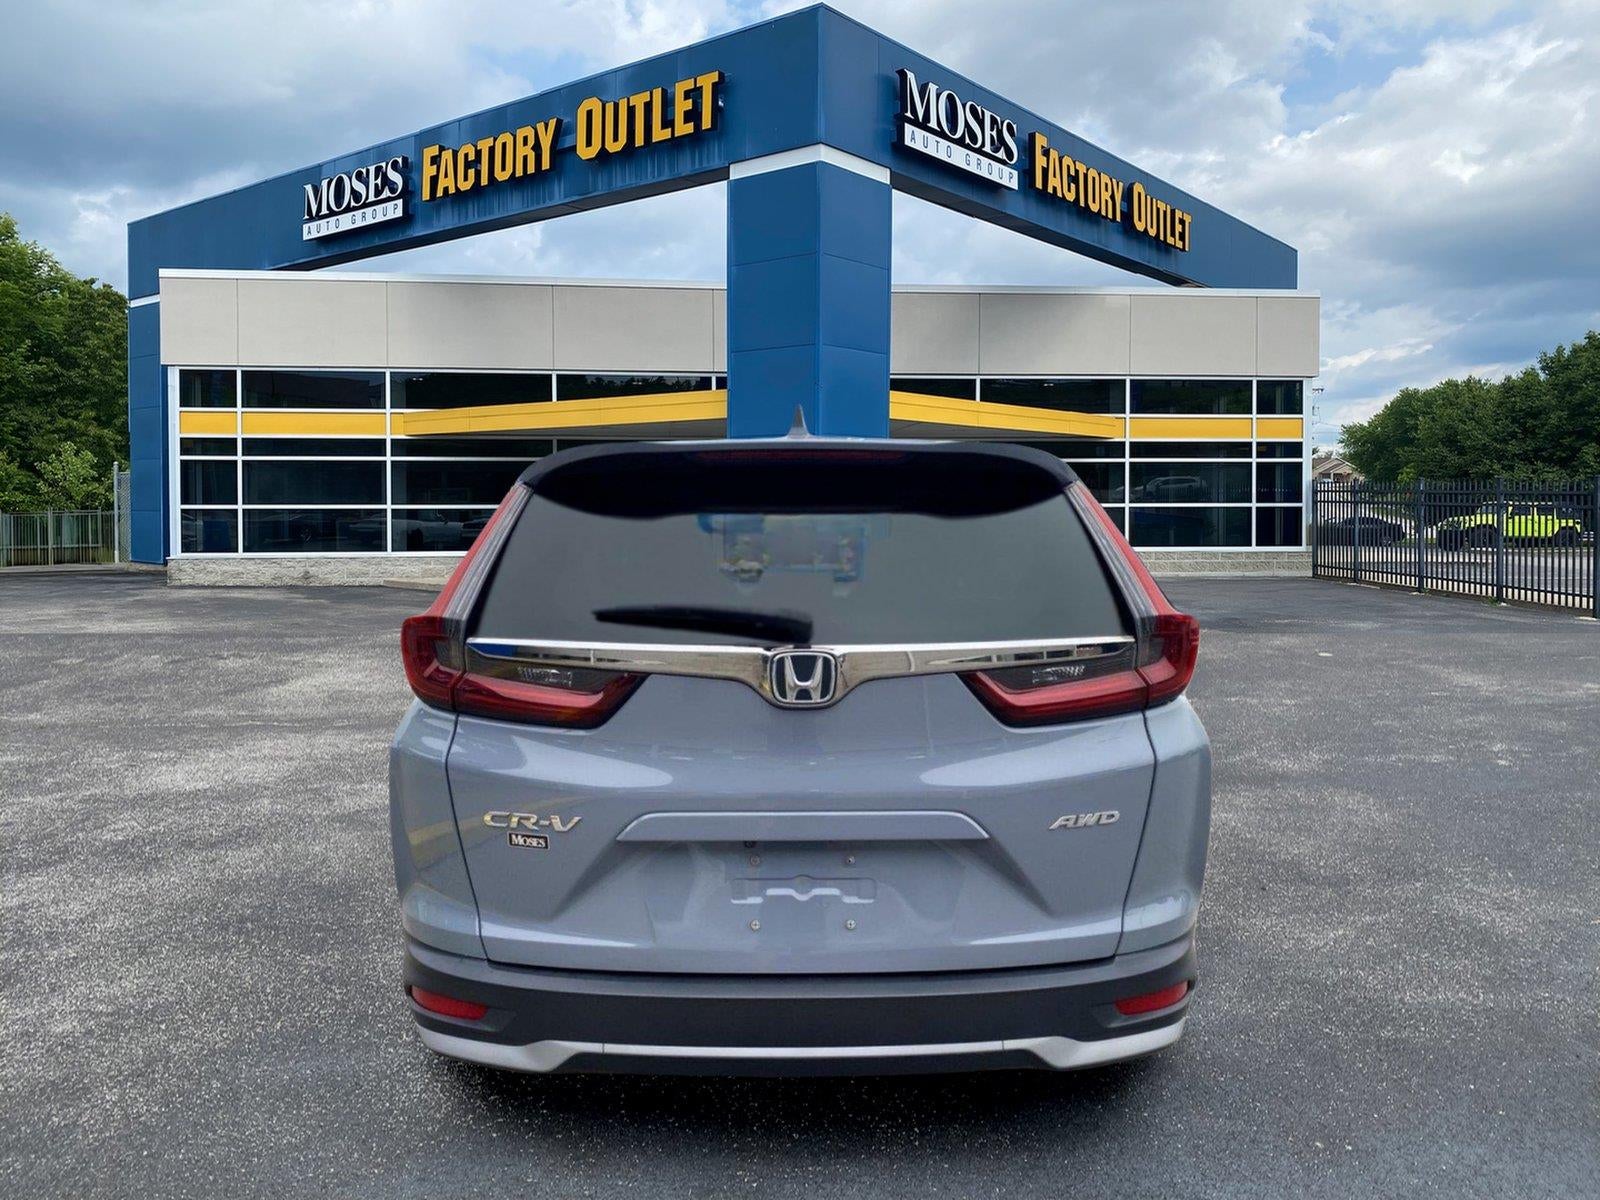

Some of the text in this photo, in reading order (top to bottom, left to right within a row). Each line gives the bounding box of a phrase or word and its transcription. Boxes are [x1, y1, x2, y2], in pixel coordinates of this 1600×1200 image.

[421, 70, 720, 201] FACTORY OUTLET
[904, 68, 1018, 165] MOSES
[909, 129, 1015, 184] AUTO GROUP
[302, 156, 404, 220] MOSES
[1034, 131, 1192, 251] FACTORY OUTLET
[306, 203, 400, 237] AUTO GROUP
[483, 810, 582, 832] CR-V
[511, 834, 546, 848] MOSES
[1048, 810, 1121, 831] AWD
